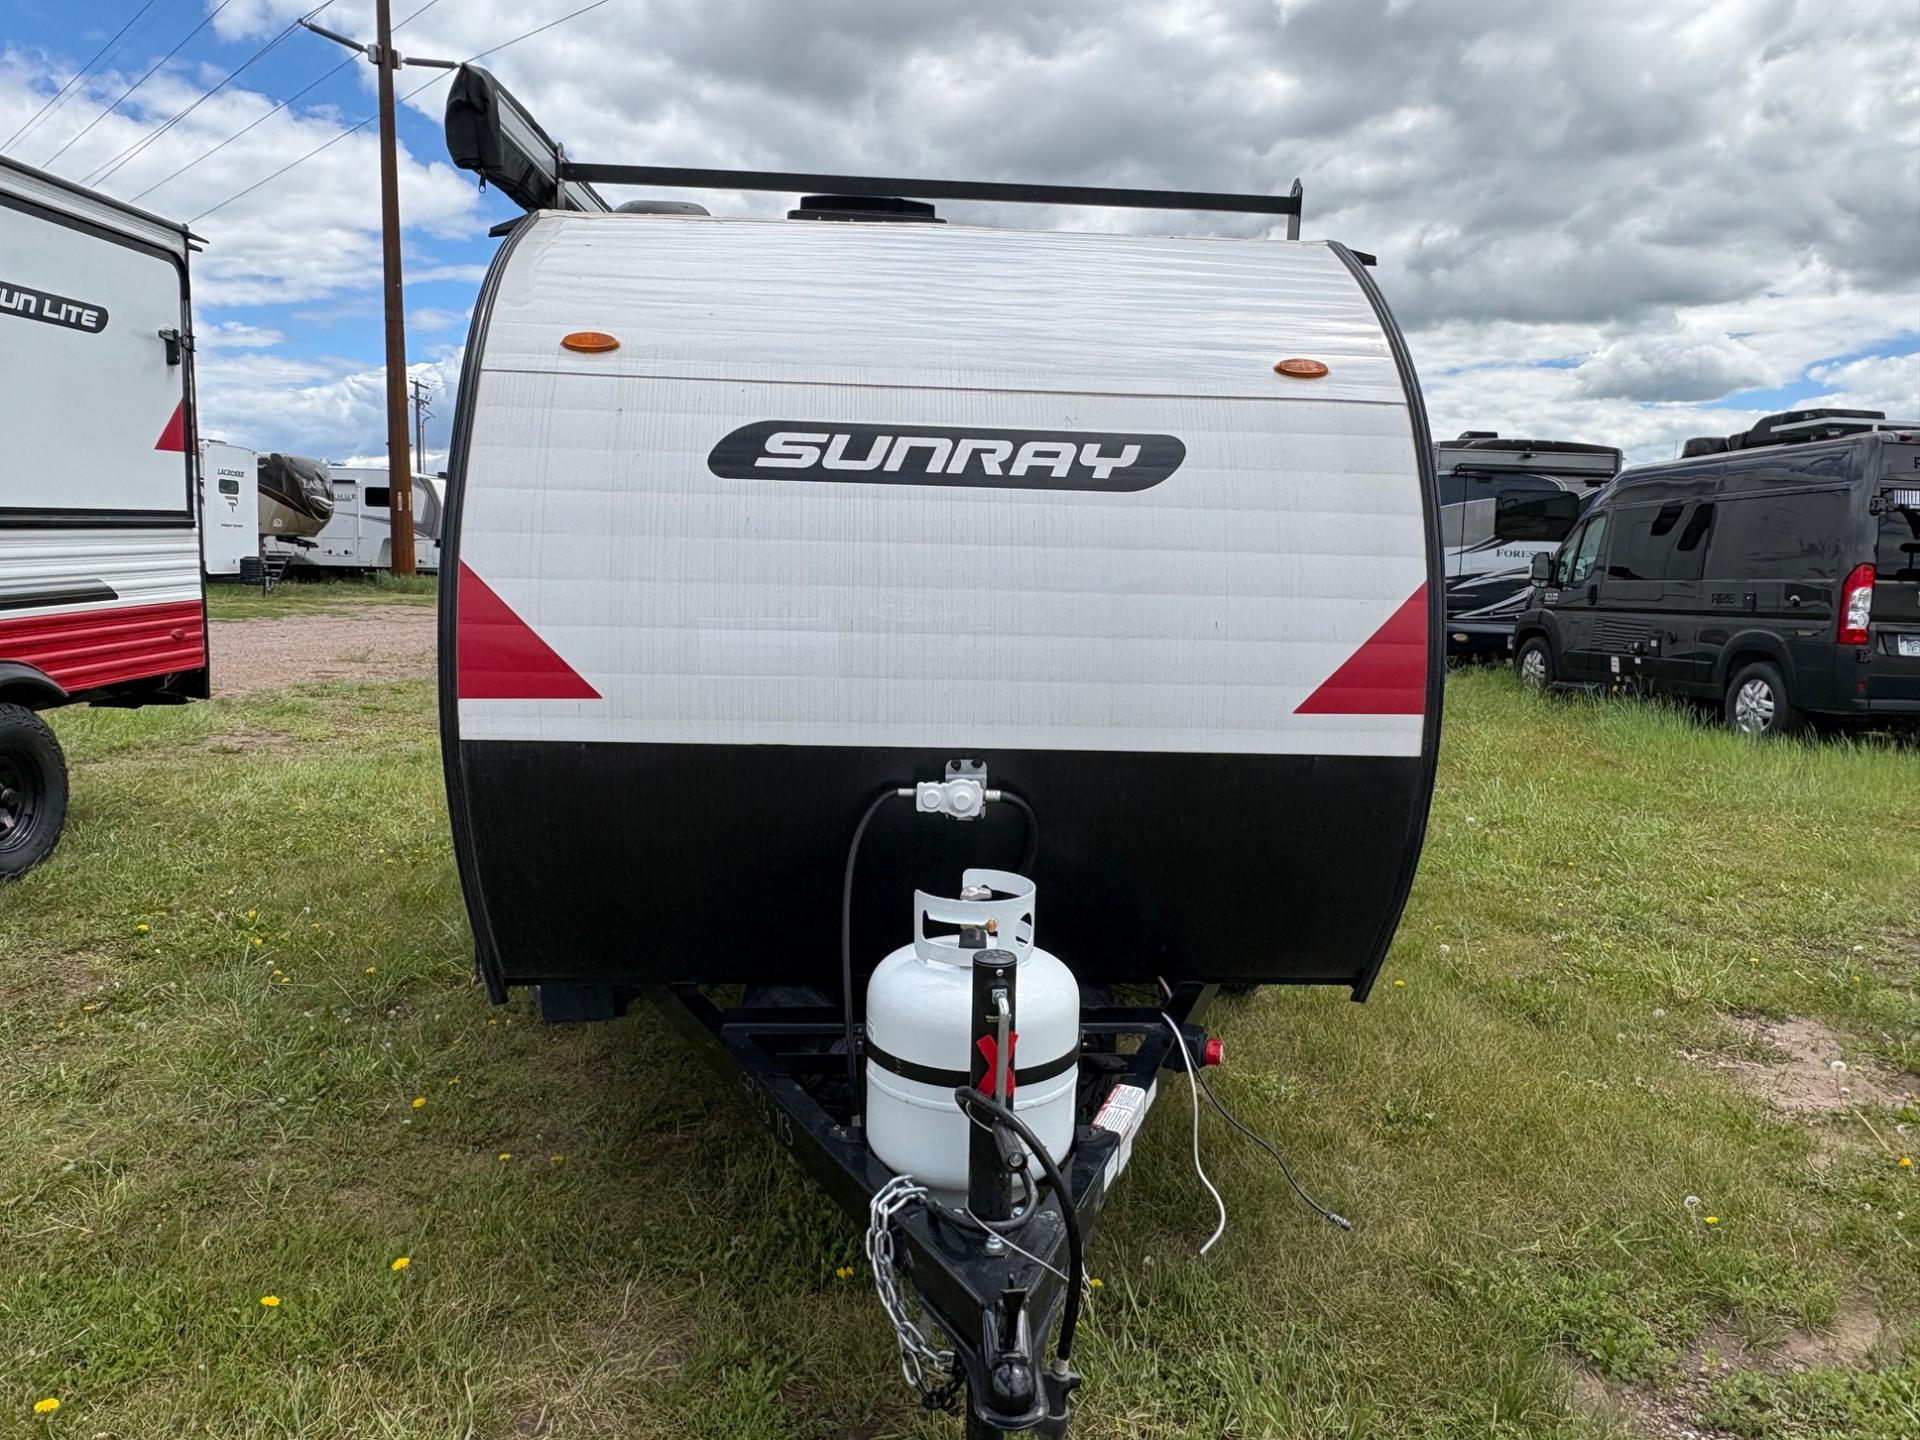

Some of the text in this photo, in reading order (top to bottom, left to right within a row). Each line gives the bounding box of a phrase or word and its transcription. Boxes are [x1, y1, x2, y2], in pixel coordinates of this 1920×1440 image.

[0, 287, 99, 327] UN LITE
[754, 431, 1142, 479] SUNRAY
